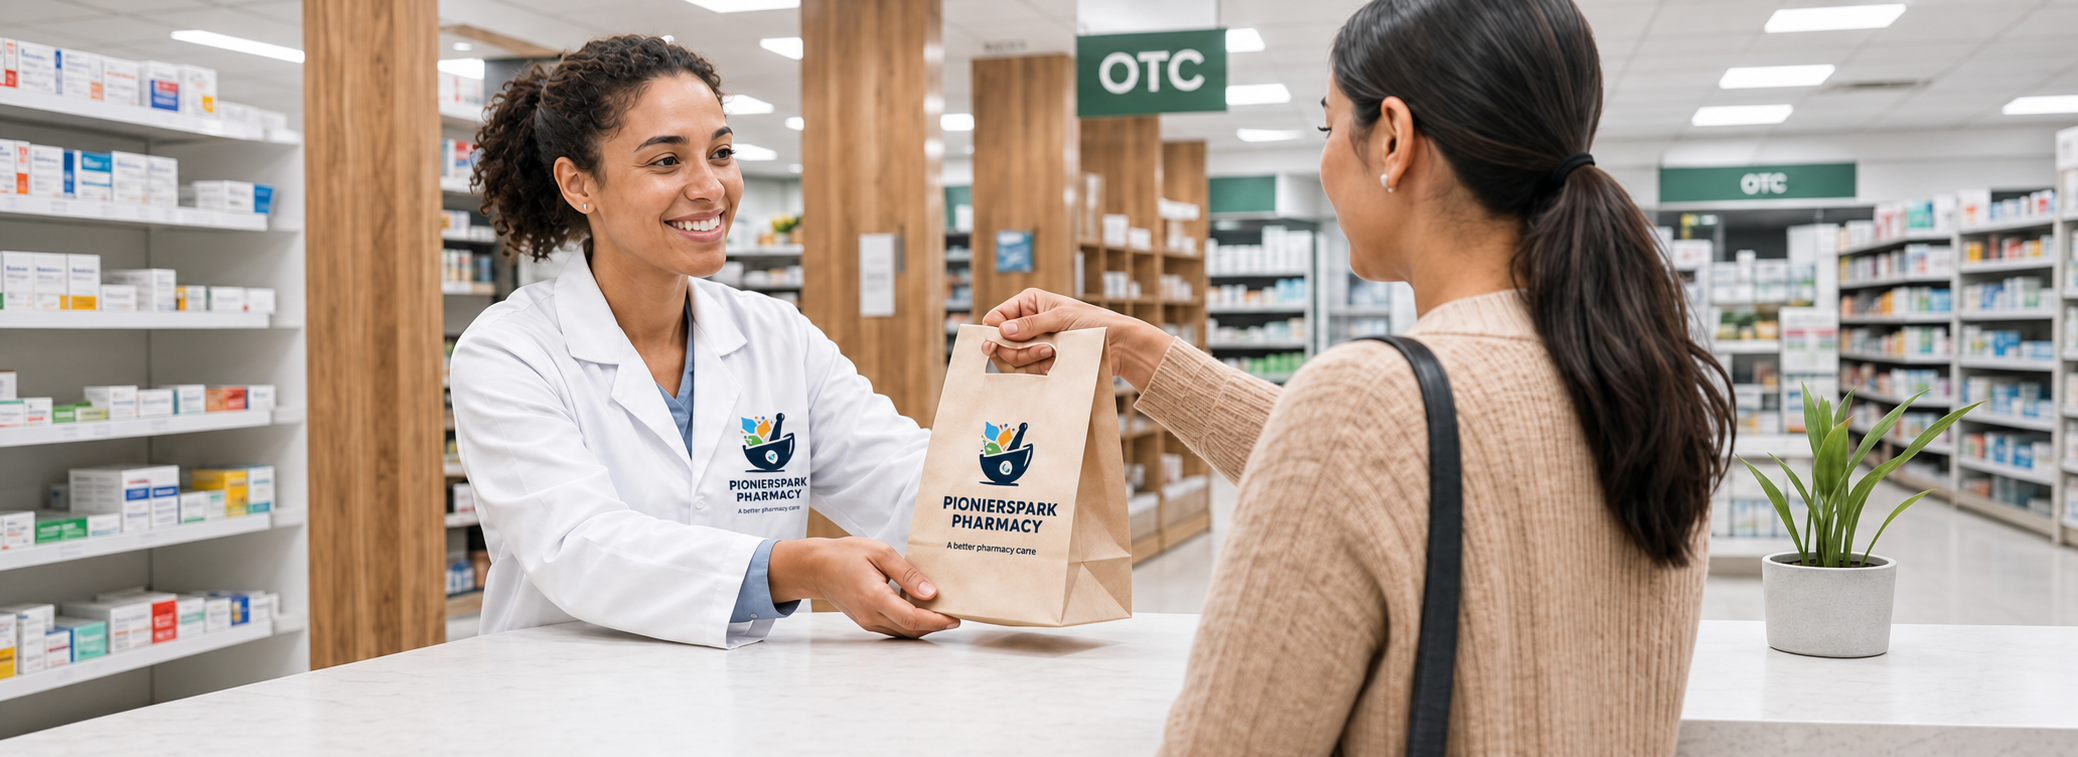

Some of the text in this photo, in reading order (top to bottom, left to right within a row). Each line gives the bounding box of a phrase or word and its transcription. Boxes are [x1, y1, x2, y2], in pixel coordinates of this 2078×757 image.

[1099, 48, 1206, 95] OTC
[1740, 172, 1788, 196] OTC
[729, 477, 807, 490] PIONIERSPARK
[737, 489, 802, 502] PHARMACY
[943, 496, 1058, 516] PIONIERSPARK
[951, 514, 1043, 533] PHARMACY
[947, 541, 953, 549] A
[953, 542, 976, 551] better
[976, 544, 1015, 556] pharmacy
